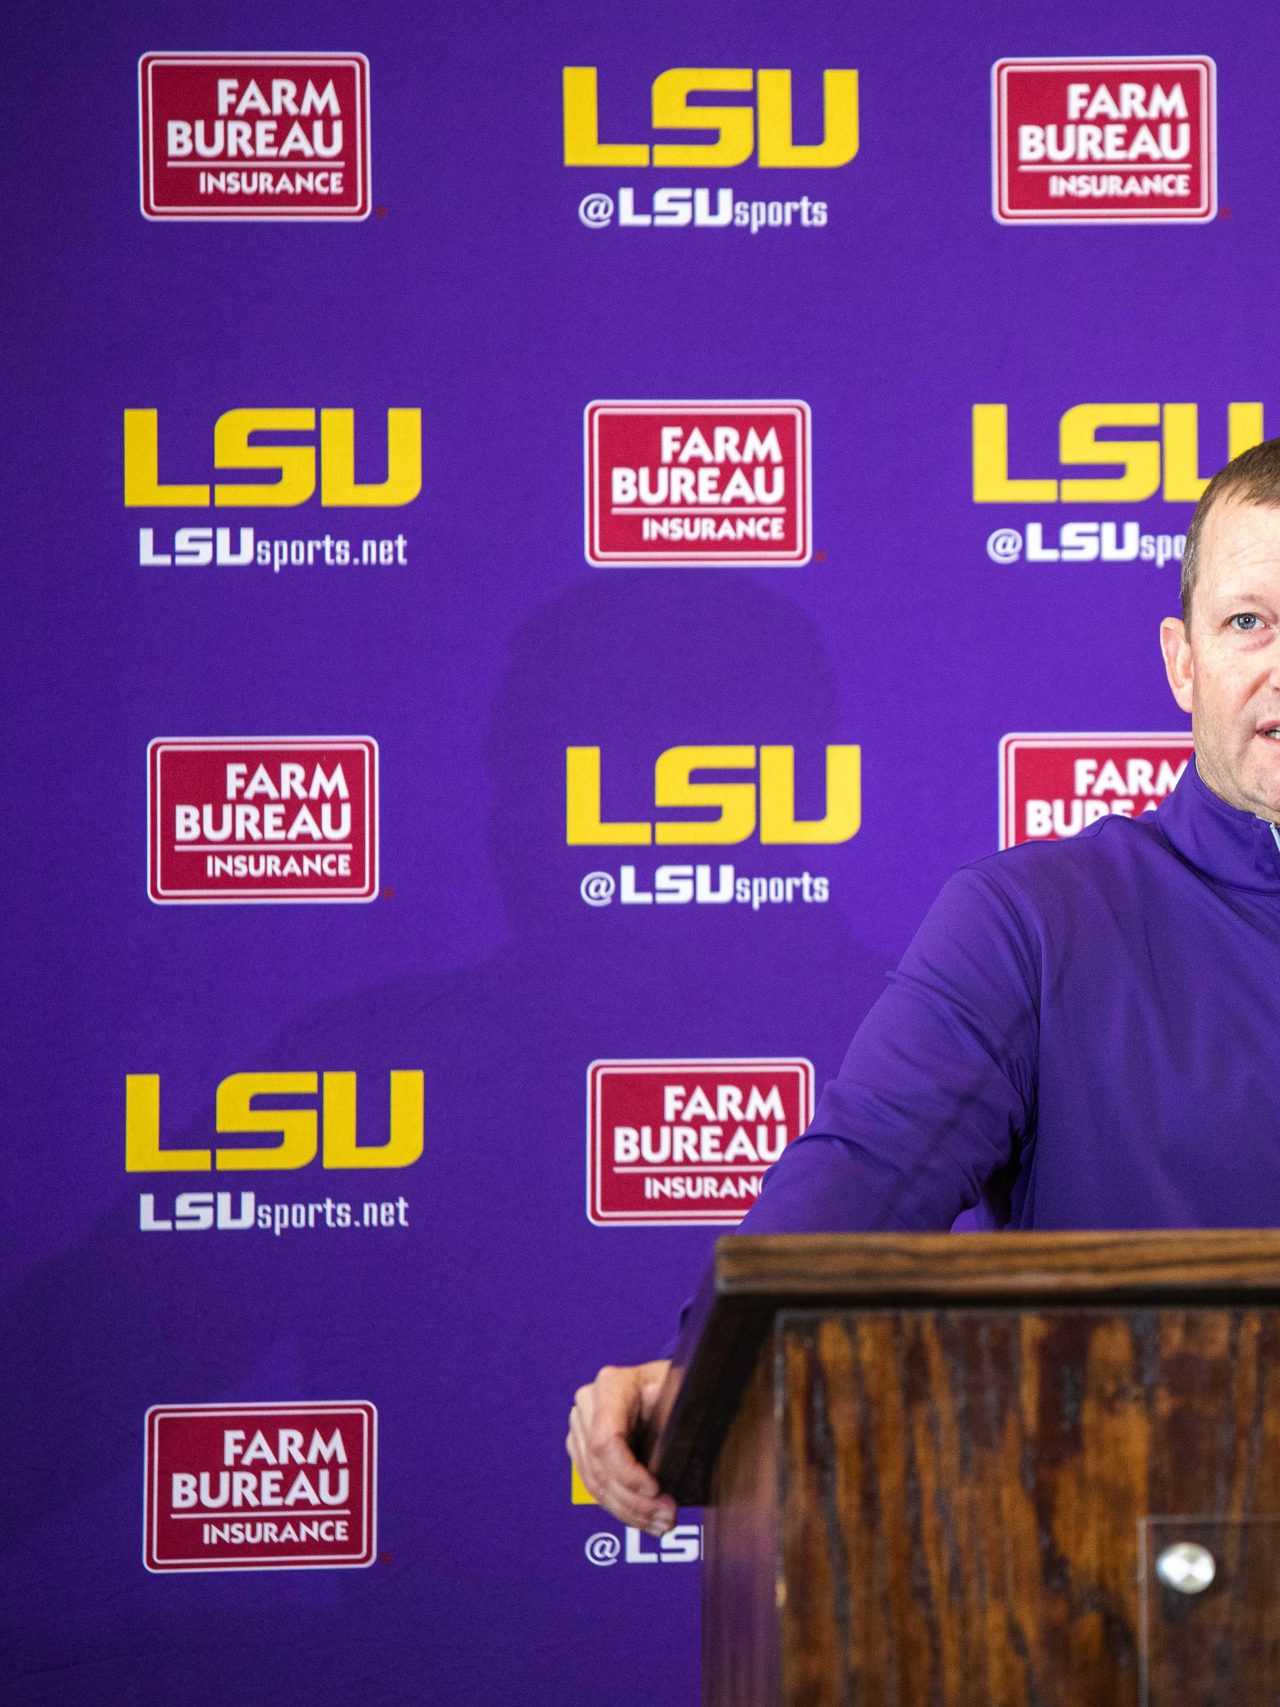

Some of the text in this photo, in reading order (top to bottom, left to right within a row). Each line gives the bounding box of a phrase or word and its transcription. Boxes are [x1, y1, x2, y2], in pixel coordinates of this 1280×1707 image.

[218, 79, 340, 116] FARM
[1068, 83, 1188, 120] FARM
[563, 67, 859, 168] LSU
[168, 120, 342, 157] BUREAU
[1019, 123, 1190, 161] BUREAU
[200, 172, 343, 194] INSURANCE
[1050, 174, 1190, 197] INSURANCE
[579, 188, 827, 233] @LSUsports
[124, 408, 422, 507] LSU
[662, 427, 782, 463] FARM
[973, 402, 1264, 503] LSU
[612, 467, 785, 505] BUREAU
[643, 517, 784, 540] INSURANCE
[140, 528, 407, 572] LSUsports.net
[227, 763, 349, 799] FARM
[567, 745, 861, 845] LSU
[176, 803, 352, 841] BUREAU
[207, 854, 350, 877] INSURANCE
[581, 865, 828, 909] @LSUsports
[125, 1070, 424, 1172] LSU
[665, 1085, 785, 1121] FARM
[615, 1125, 787, 1164] BUREAU
[645, 1176, 763, 1198] INSURAN
[140, 1192, 408, 1235] LSUsports.net
[224, 1429, 347, 1466] FARM
[172, 1469, 349, 1507] BUREAU
[204, 1521, 348, 1544] INSURANCE
[585, 1525, 704, 1566] @LS
